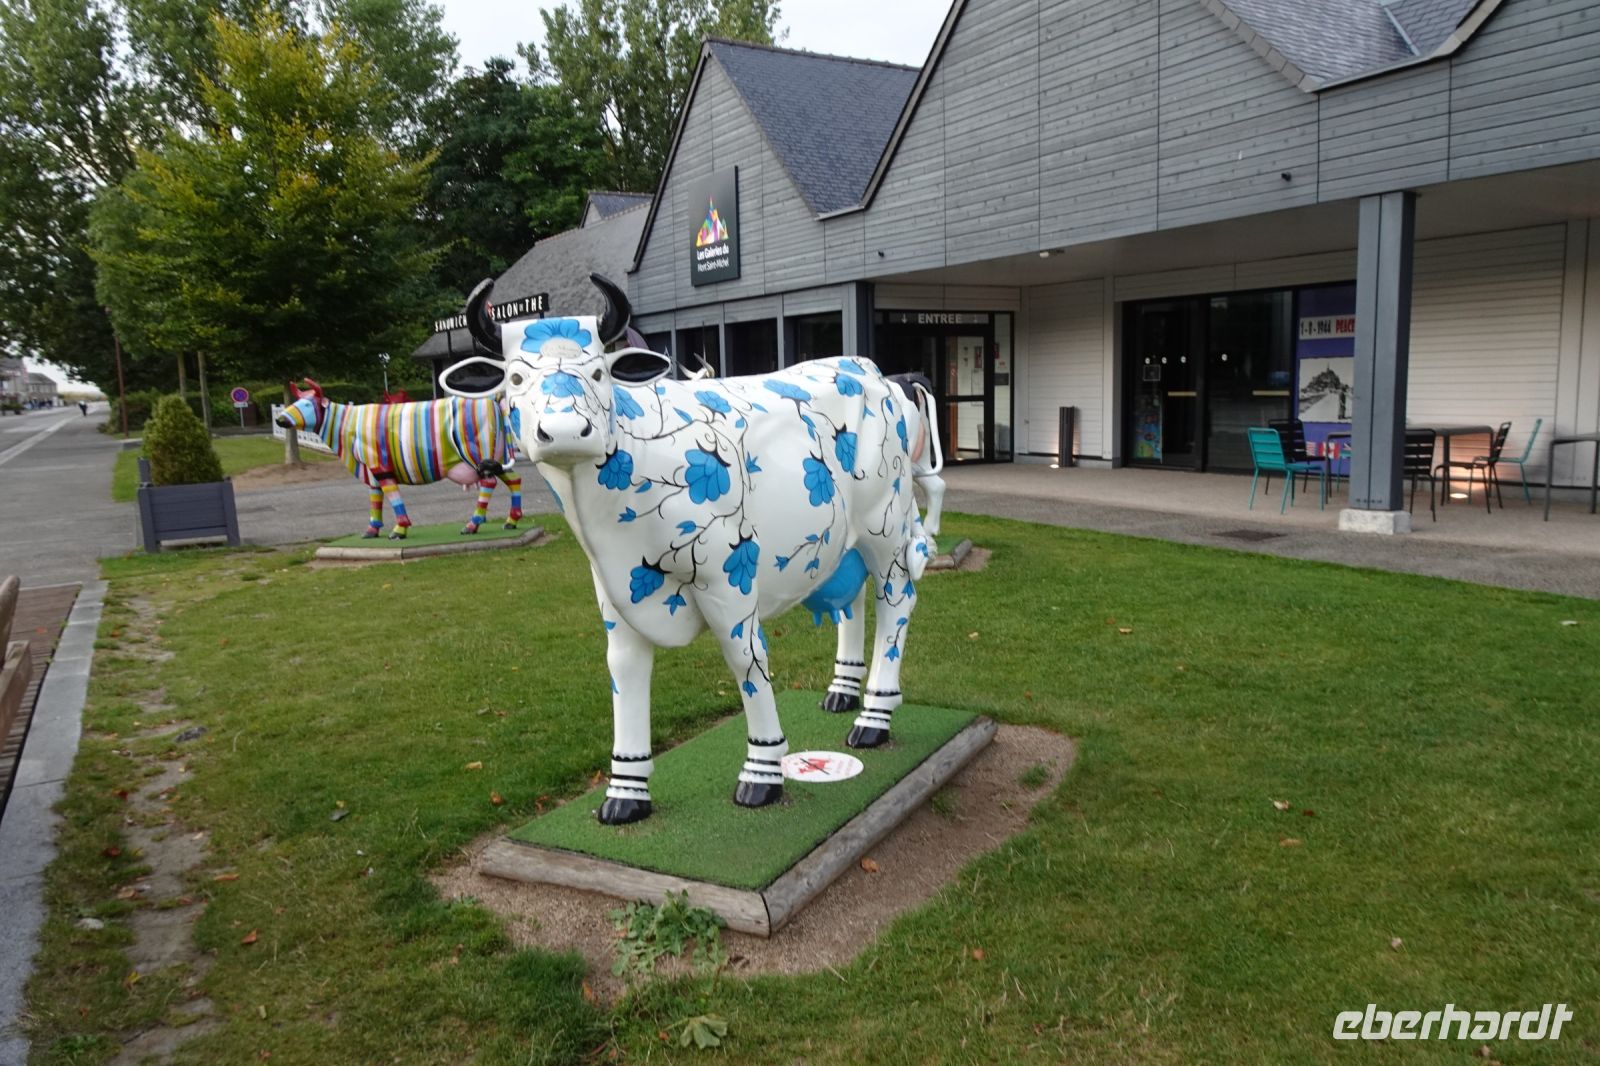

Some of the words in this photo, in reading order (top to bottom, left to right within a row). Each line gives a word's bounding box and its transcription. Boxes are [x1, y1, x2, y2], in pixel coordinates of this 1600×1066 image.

[697, 250, 705, 260] Les
[705, 245, 722, 258] Galeries
[491, 302, 518, 320] SALON
[525, 295, 543, 313] THE
[918, 313, 962, 324] ENTREE
